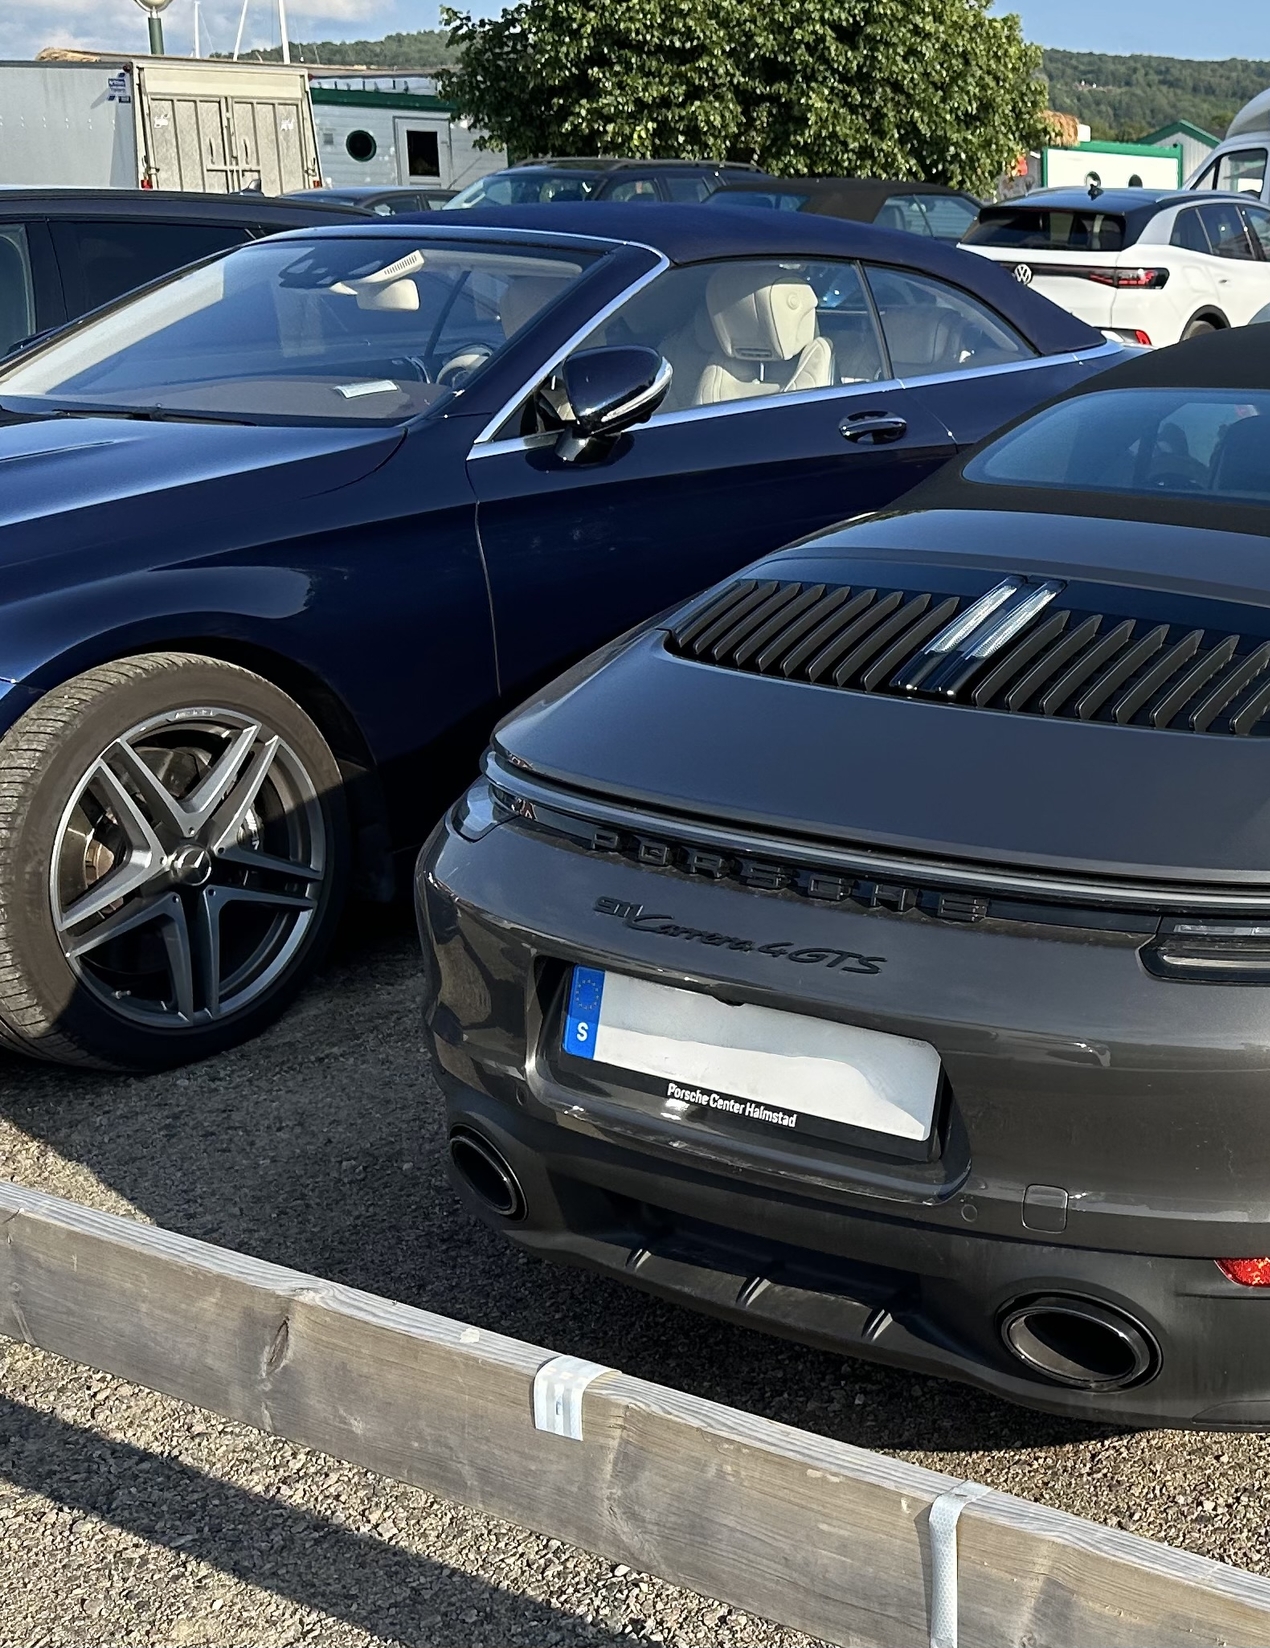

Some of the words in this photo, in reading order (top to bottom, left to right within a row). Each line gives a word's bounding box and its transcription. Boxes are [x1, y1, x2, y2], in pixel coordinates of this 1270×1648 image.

[592, 832, 986, 923] PORSCHE
[592, 896, 643, 918] 911
[624, 914, 753, 952] Carrera
[576, 1021, 589, 1042] S
[667, 1082, 710, 1106] Porsche
[709, 1093, 745, 1115] Center
[745, 1102, 798, 1128] Halmstad
